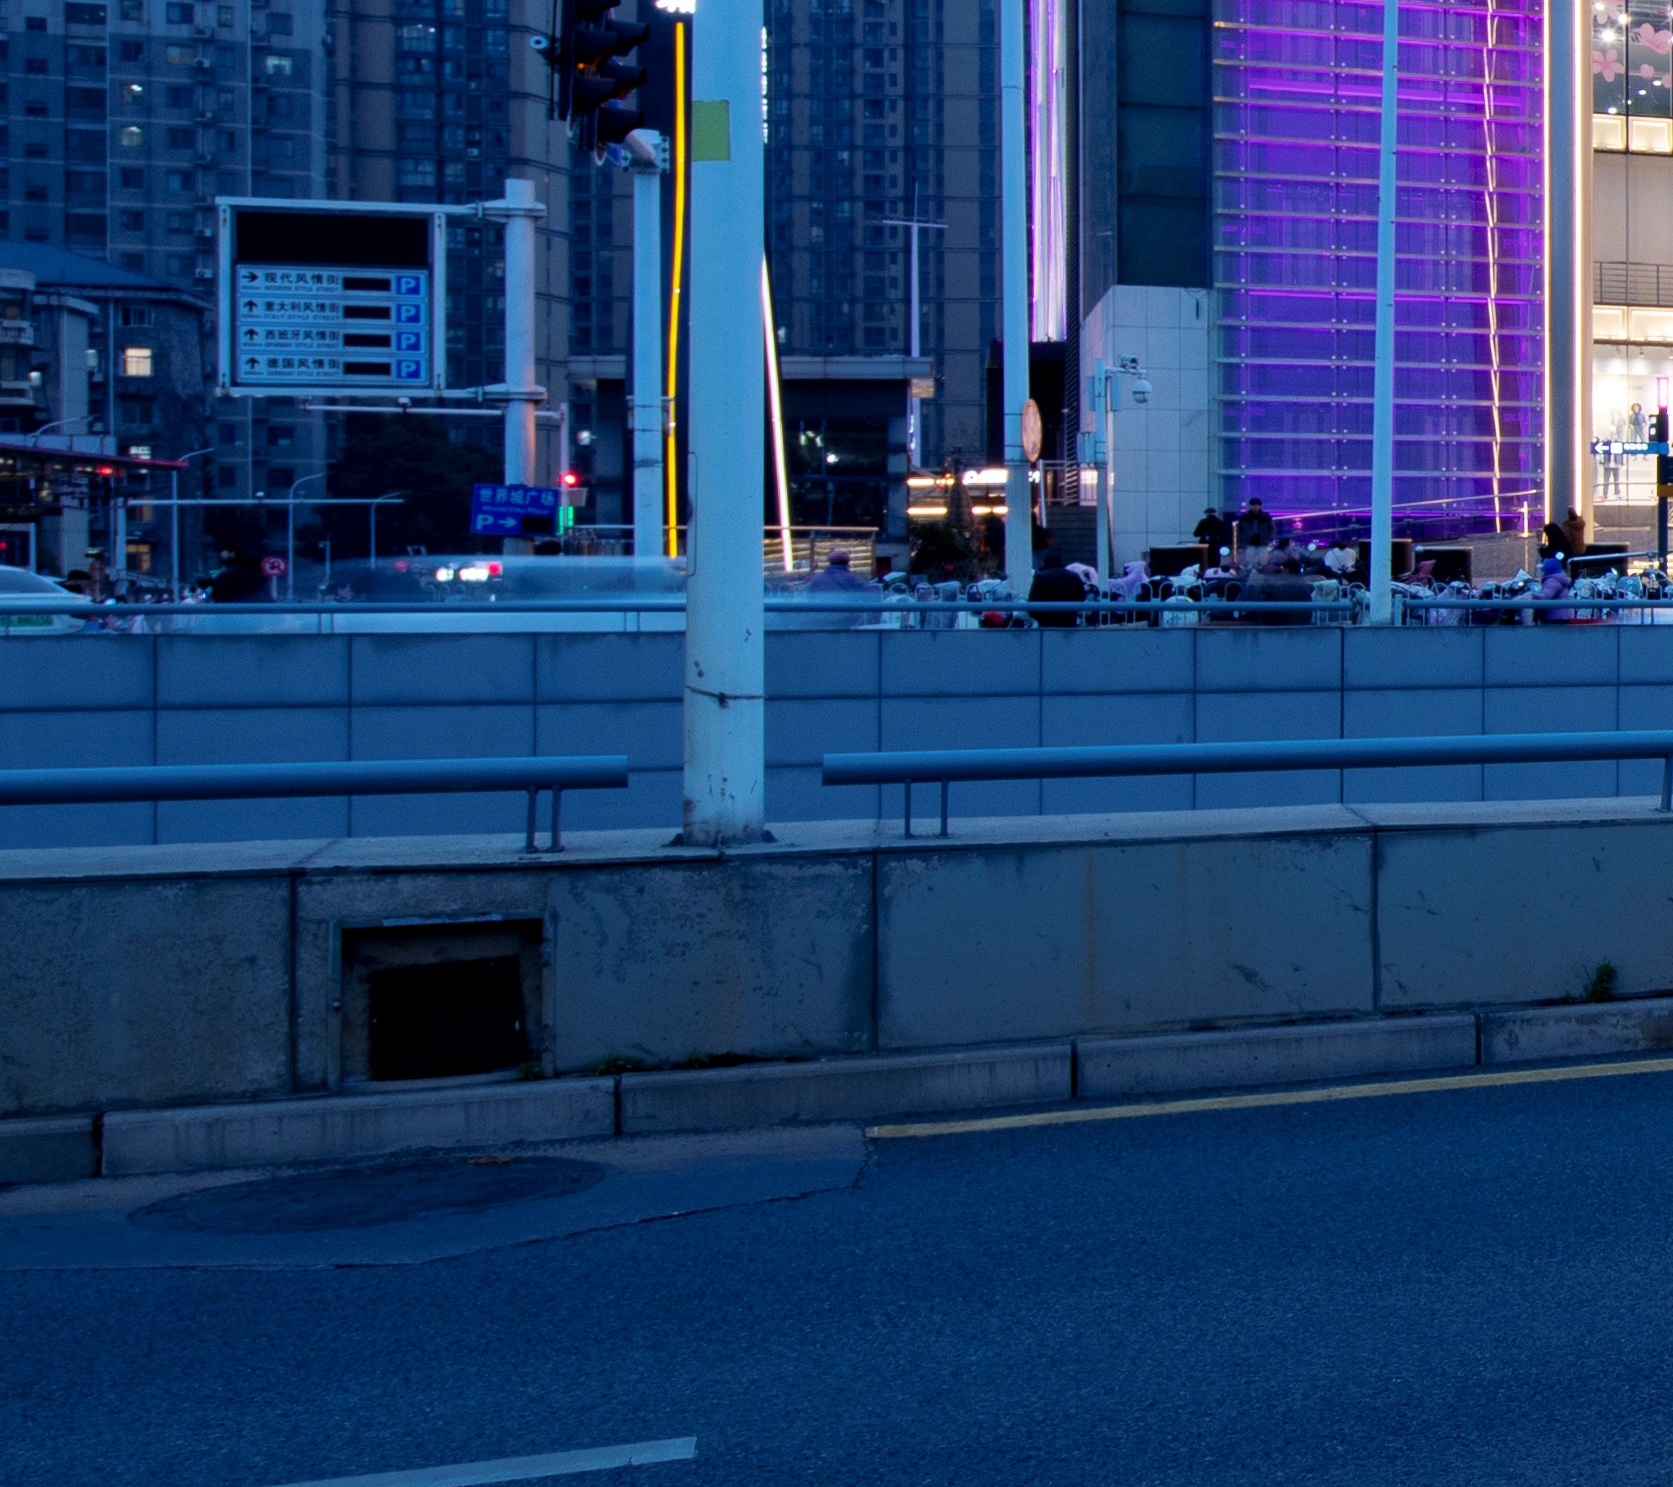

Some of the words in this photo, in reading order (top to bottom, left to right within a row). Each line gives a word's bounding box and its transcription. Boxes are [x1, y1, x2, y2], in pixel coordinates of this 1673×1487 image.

[265, 272, 339, 285] 现代风情街
[401, 278, 416, 293] P
[264, 301, 340, 313] 意大利风情街
[401, 306, 416, 322] P
[401, 334, 416, 350] P
[401, 362, 416, 378] P
[476, 514, 494, 530] P
